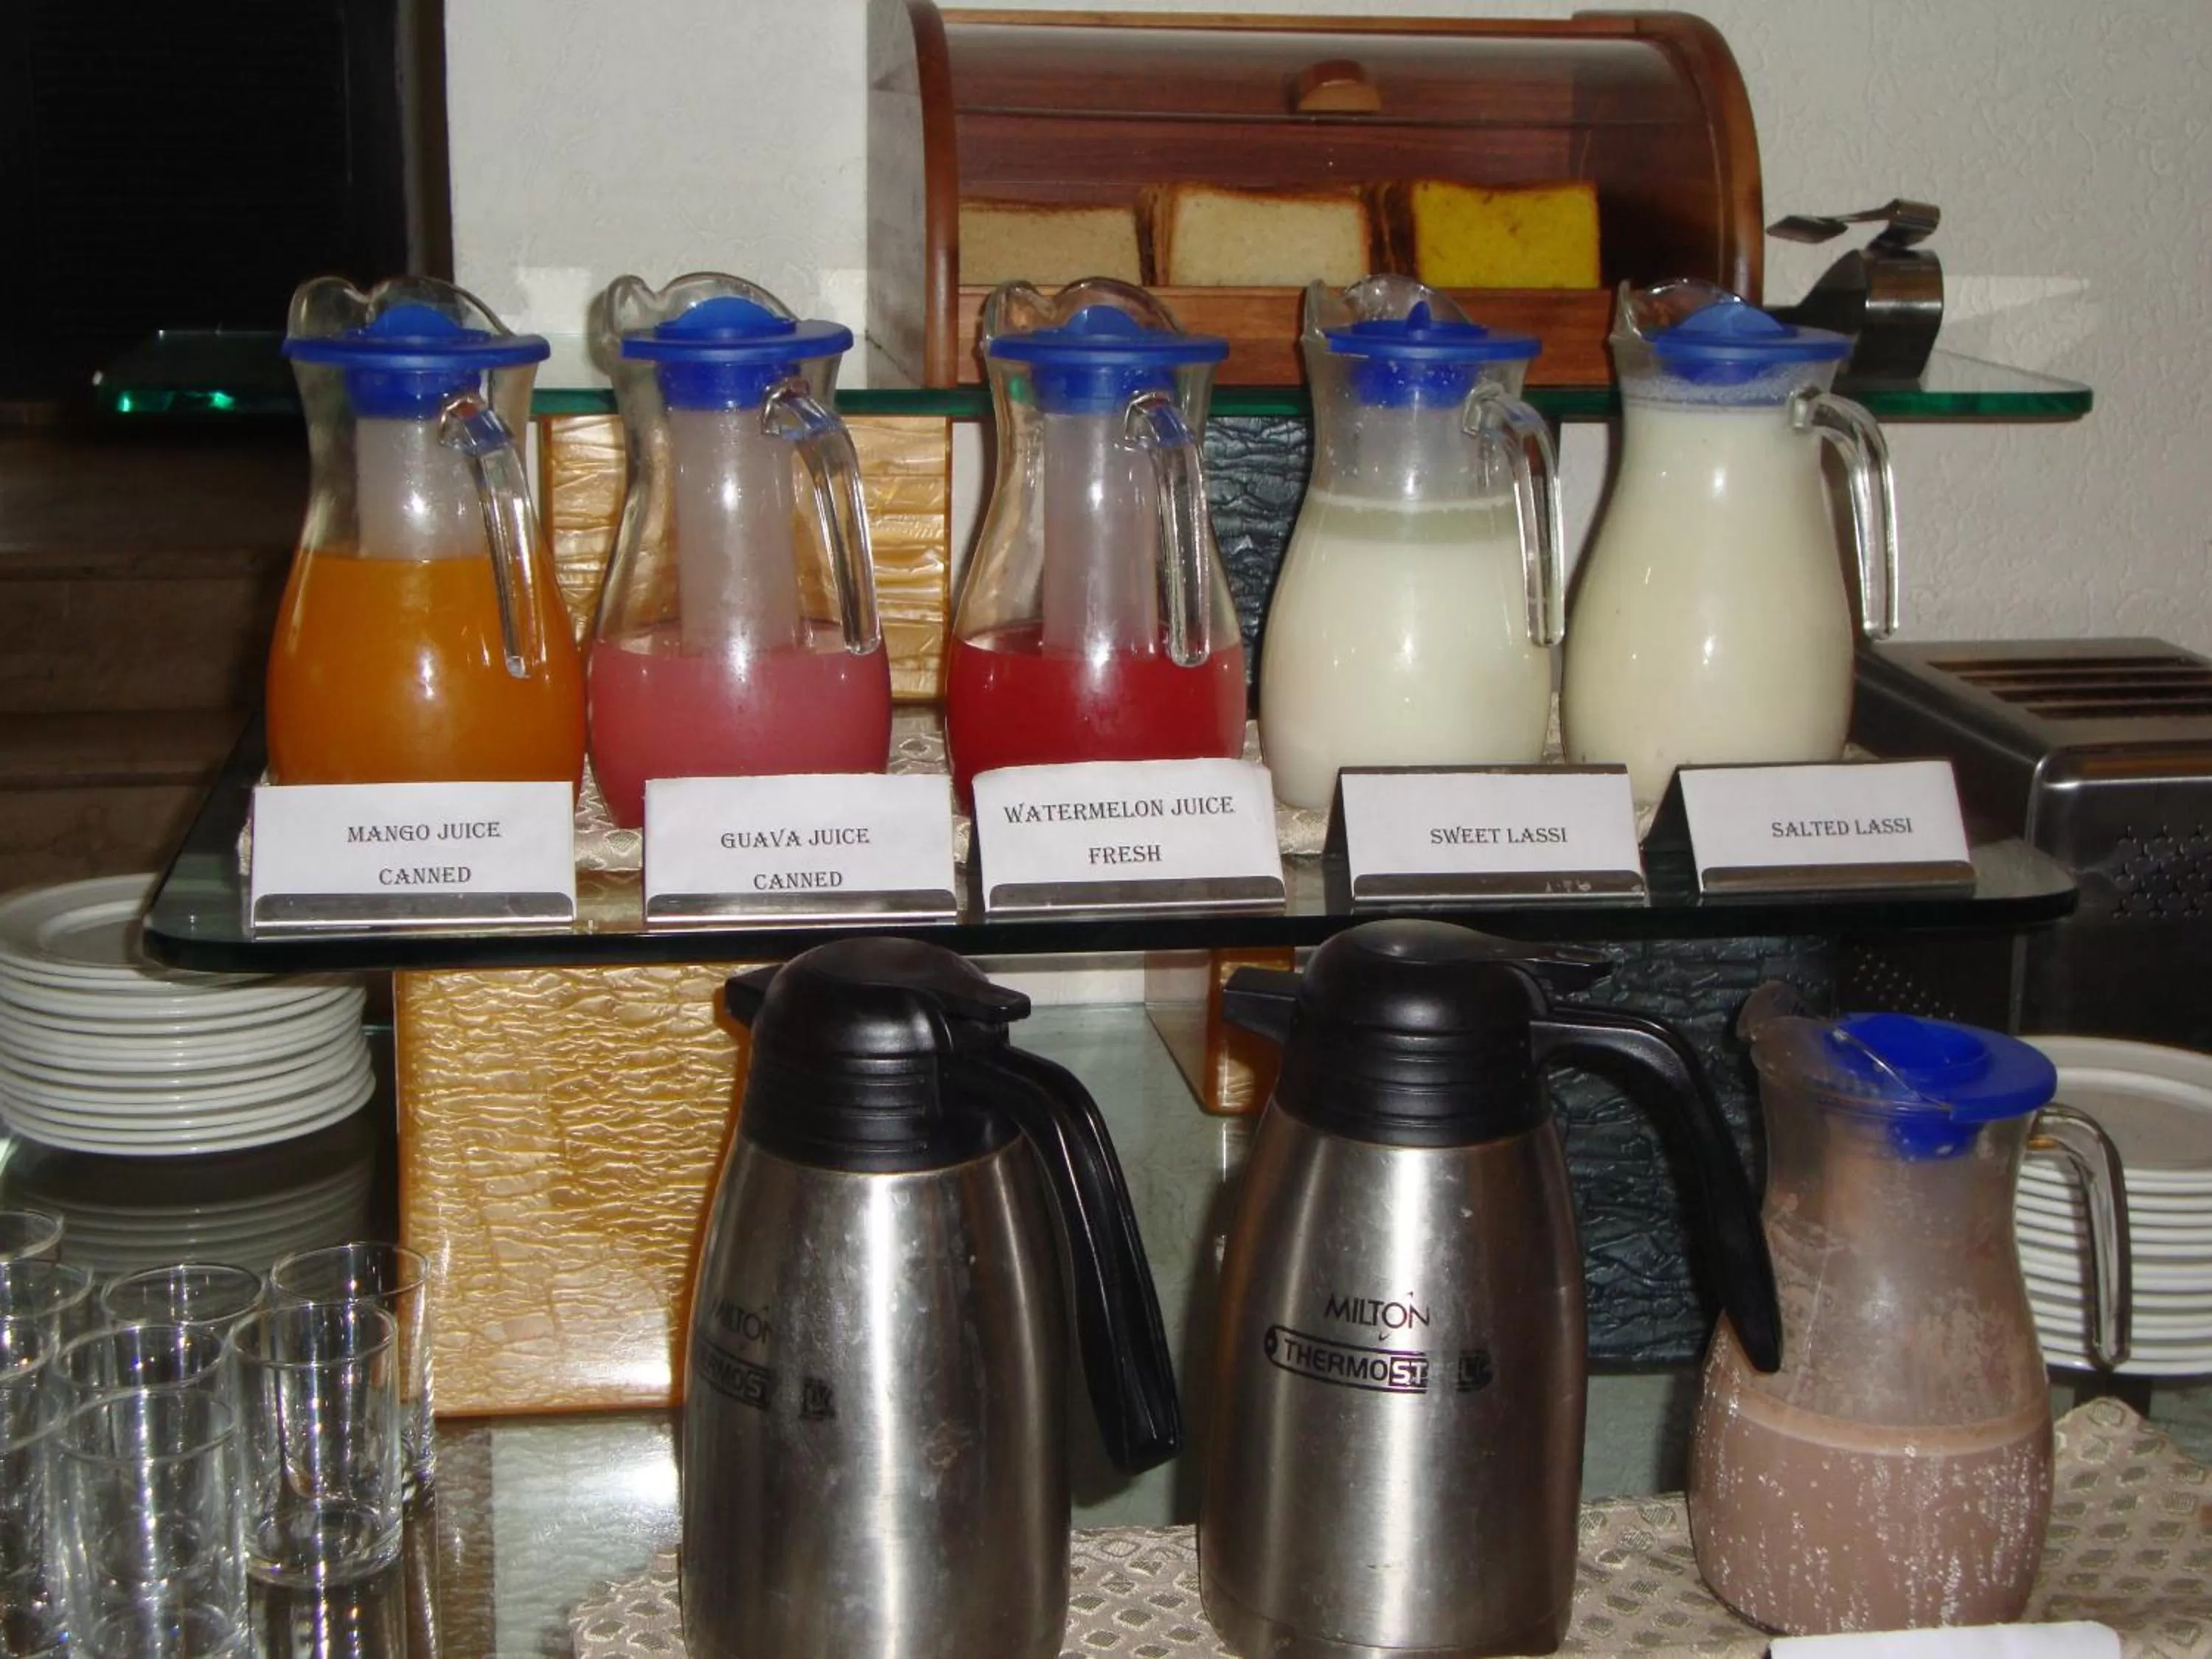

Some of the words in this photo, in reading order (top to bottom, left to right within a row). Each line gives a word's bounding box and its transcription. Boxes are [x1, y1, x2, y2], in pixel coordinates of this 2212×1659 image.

[1004, 799, 1164, 824] WATERMELON
[1170, 796, 1236, 817] JUICE
[347, 824, 431, 844] MANGO
[437, 821, 502, 841] JUICE
[720, 829, 803, 850] GUAVA
[807, 827, 872, 847] JUICE
[1430, 825, 1502, 845] SWEET
[1506, 827, 1568, 844] LASSI
[1771, 819, 1851, 839] SALTED
[1854, 817, 1914, 836] LASSI
[1088, 844, 1164, 866] FRESH
[378, 866, 473, 886] CANNED
[753, 870, 844, 891] CANNED
[1324, 1293, 1430, 1329] MILTON
